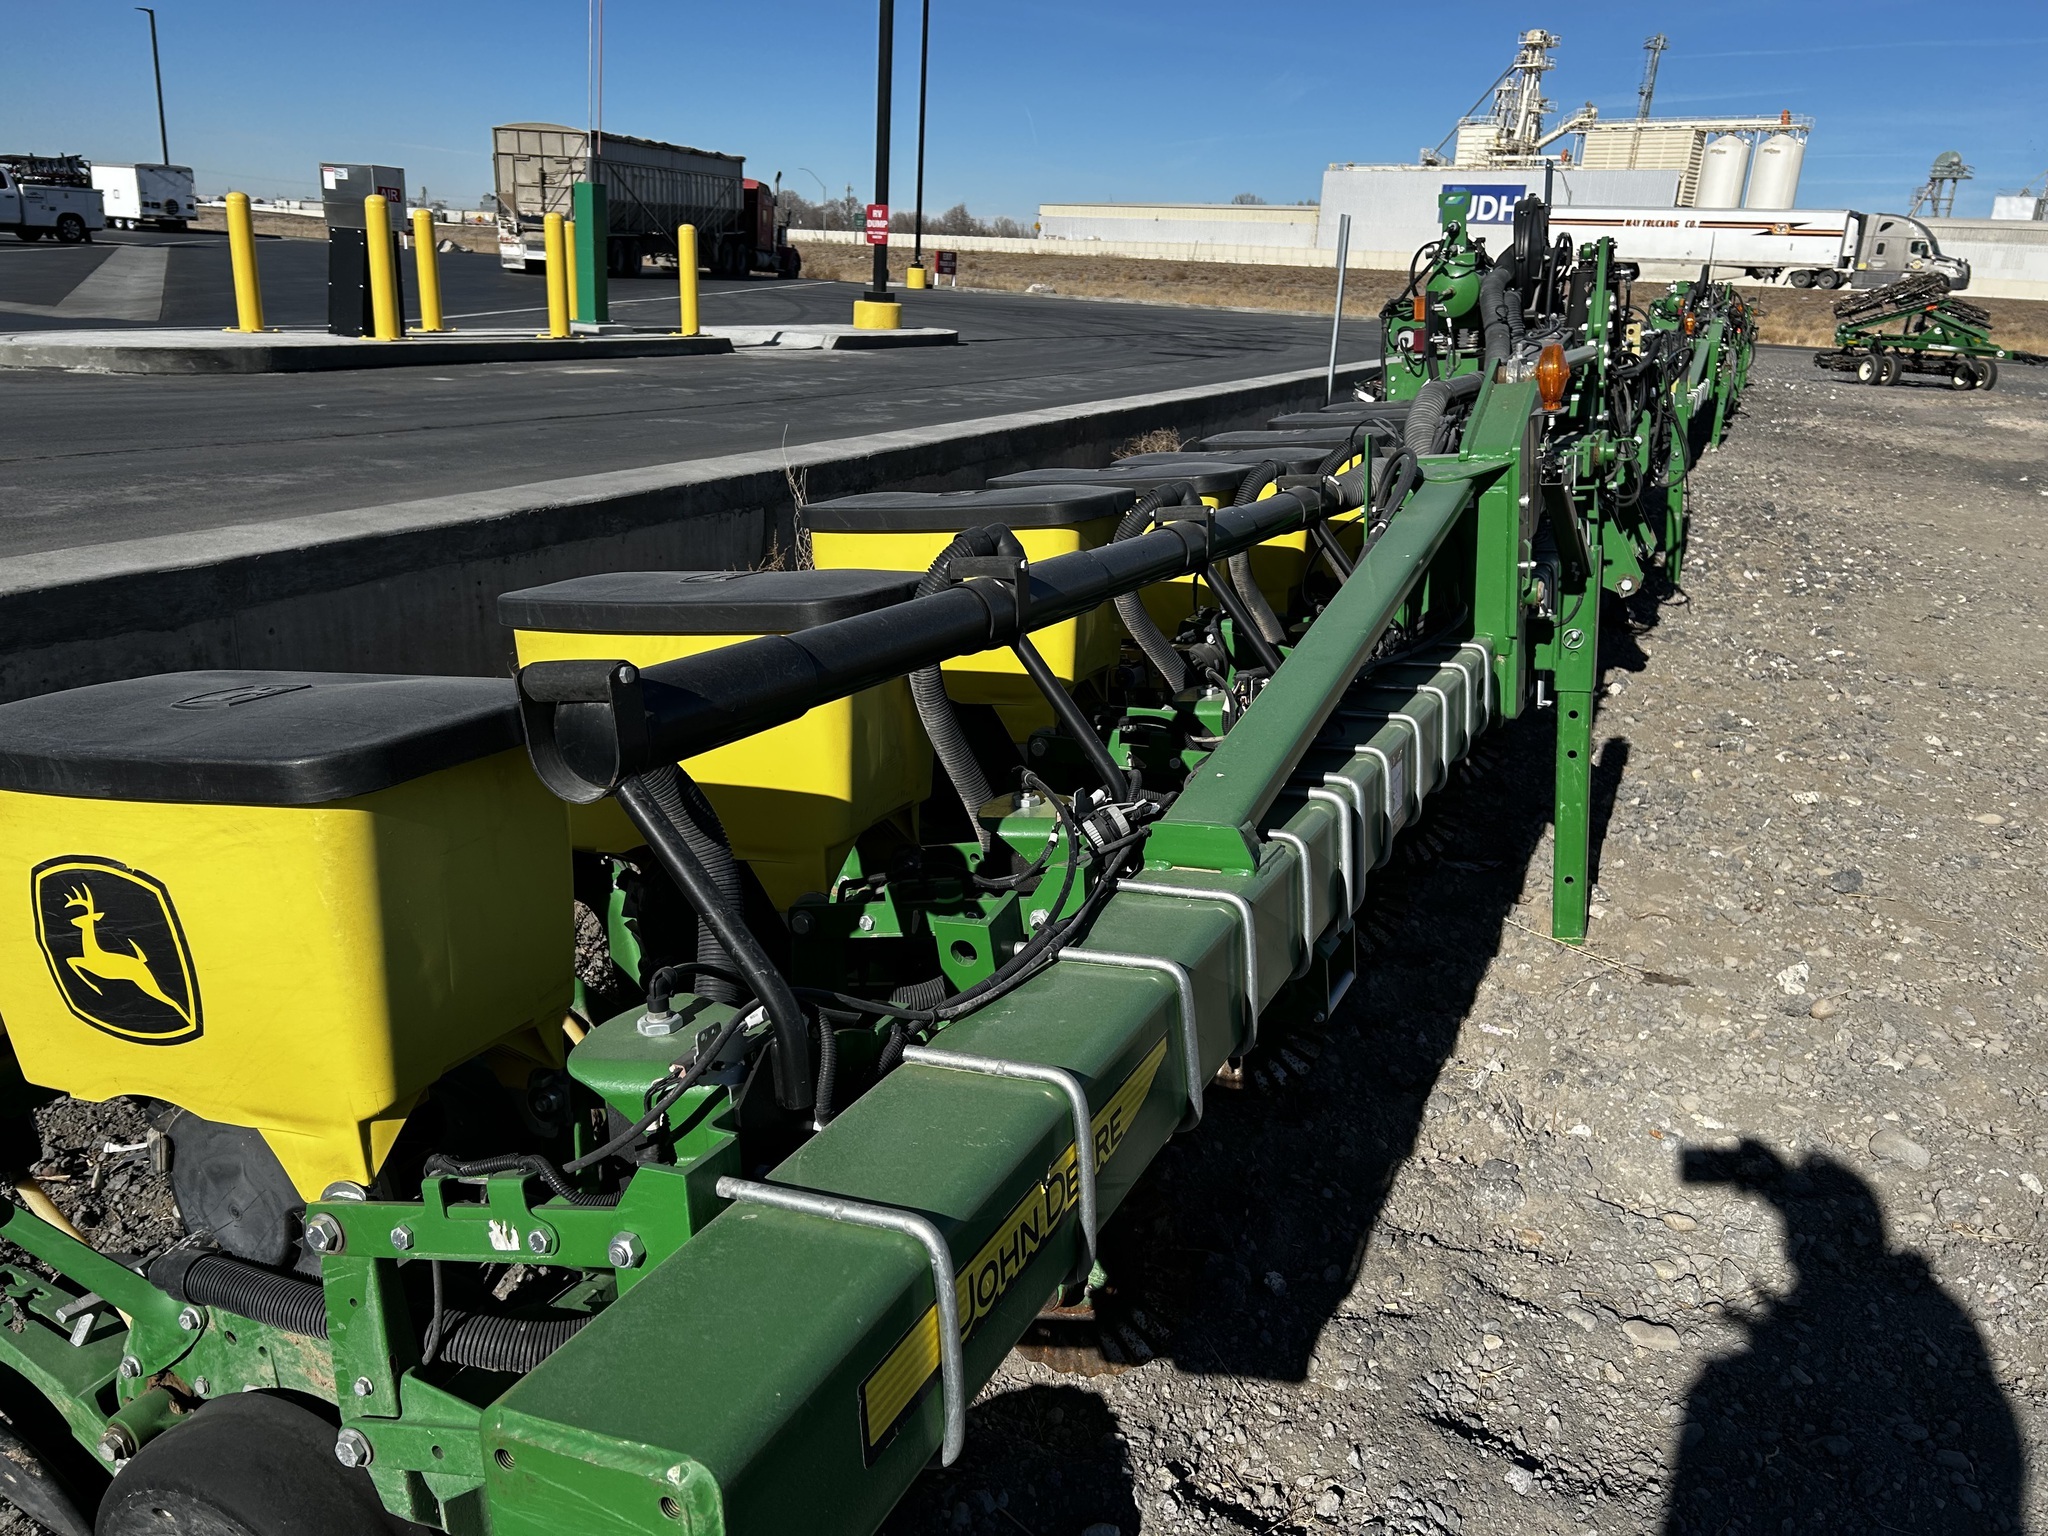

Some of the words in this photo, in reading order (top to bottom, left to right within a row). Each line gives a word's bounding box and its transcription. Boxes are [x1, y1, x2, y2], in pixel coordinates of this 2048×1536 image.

[380, 188, 399, 201] AIR
[872, 209, 883, 218] RV
[1465, 195, 1522, 221] JDH
[867, 219, 888, 228] DUMP
[1625, 219, 1640, 227] MAY
[1642, 219, 1679, 228] TRUCKING
[1684, 220, 1697, 228] CO.
[960, 1205, 1041, 1333] JOHN
[1045, 1105, 1123, 1224] DERE
